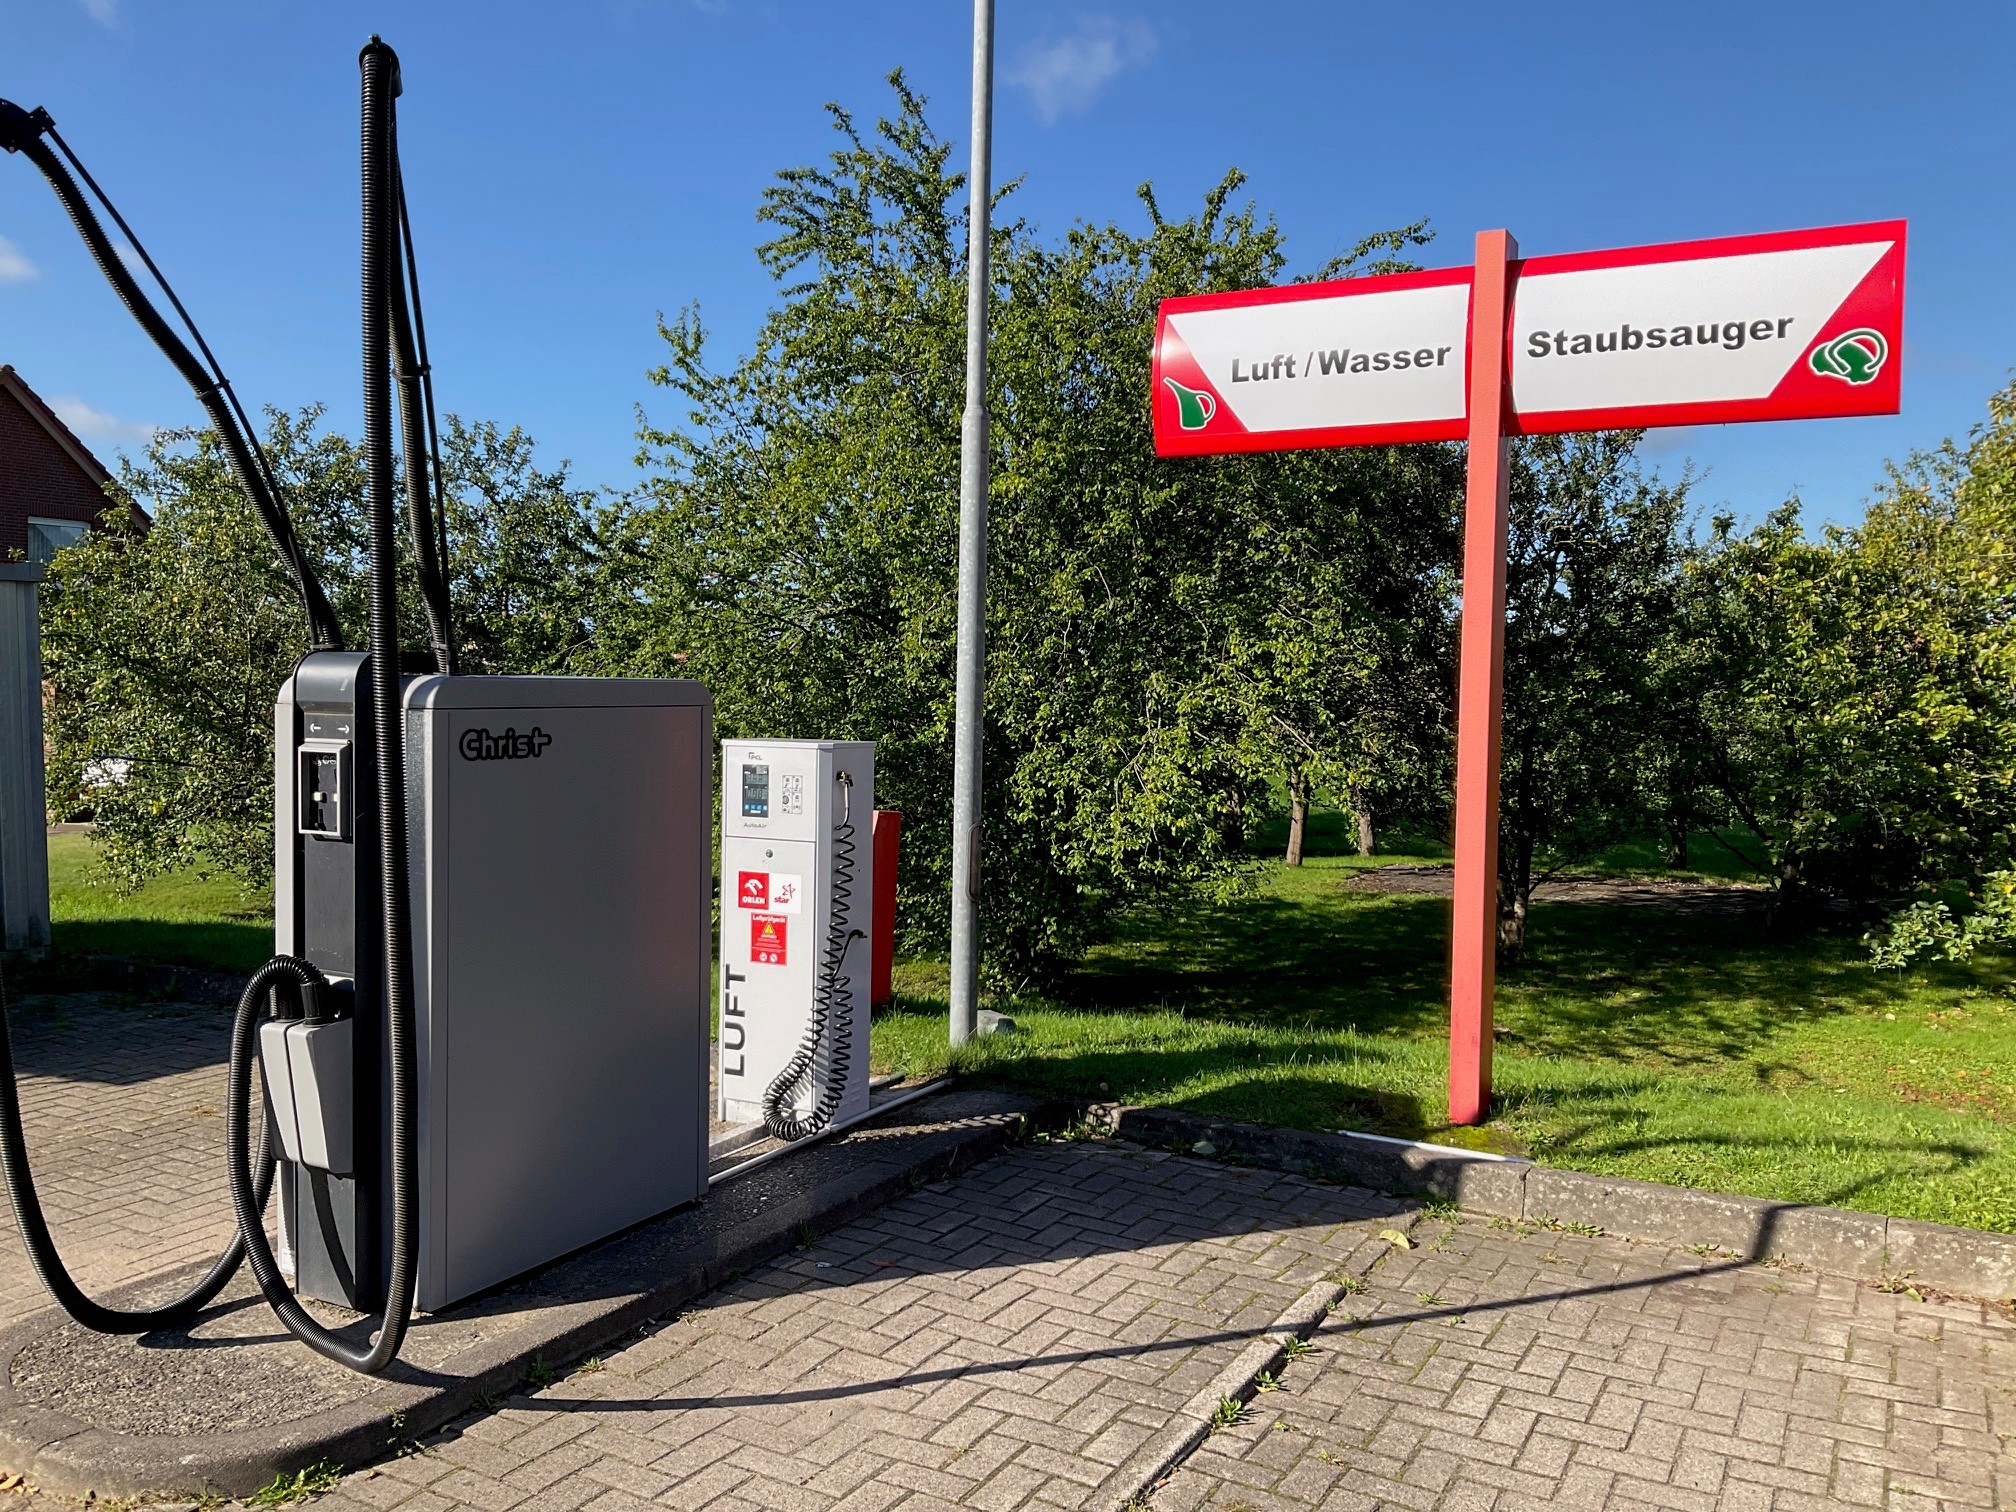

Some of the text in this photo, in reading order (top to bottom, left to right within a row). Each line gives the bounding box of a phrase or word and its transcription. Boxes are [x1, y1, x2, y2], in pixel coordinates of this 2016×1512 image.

[1527, 316, 1795, 358] Staubsauger
[459, 726, 552, 761] Christ
[742, 896, 766, 905] ORLEN
[773, 896, 790, 904] star
[724, 963, 746, 1077] LUFT
